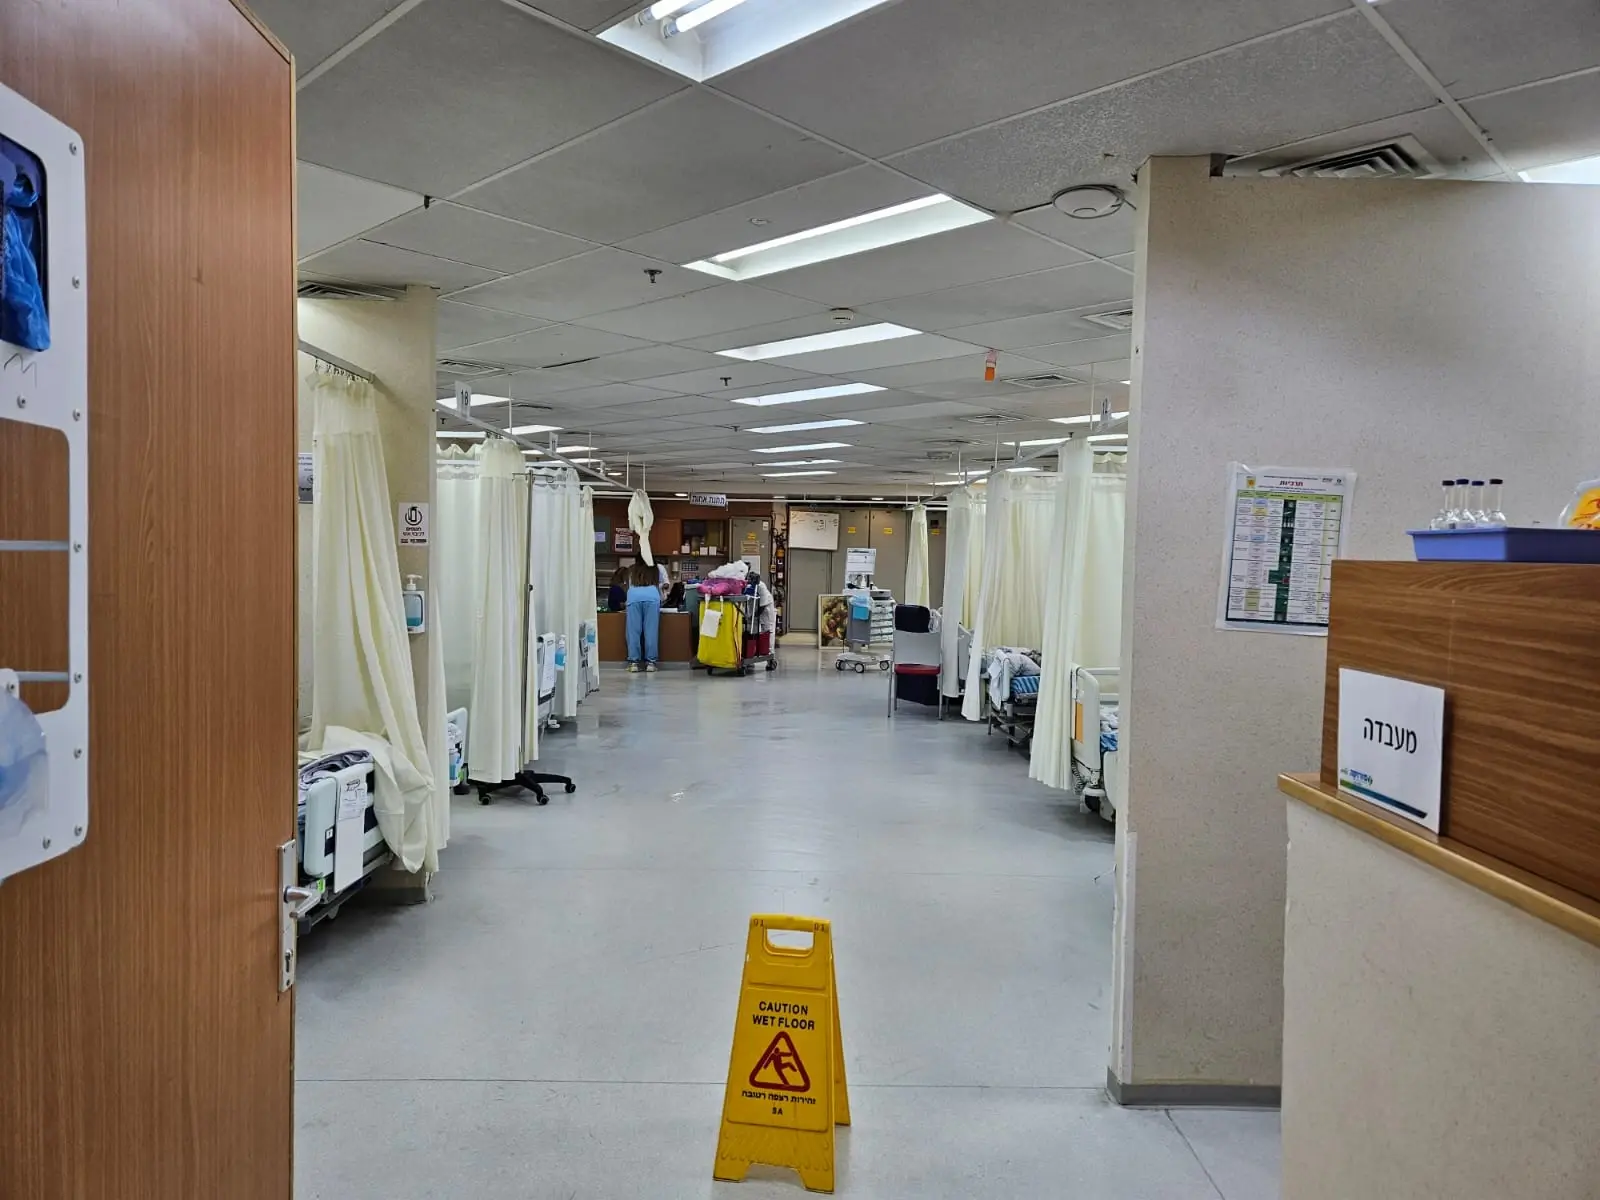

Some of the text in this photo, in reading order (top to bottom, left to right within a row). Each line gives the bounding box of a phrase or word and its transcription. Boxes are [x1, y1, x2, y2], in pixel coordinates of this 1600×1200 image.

[460, 389, 469, 406] 18
[1363, 718, 1417, 754] מעבדה
[758, 1001, 809, 1015] CAUTION
[752, 1014, 815, 1030] WET FLOOR
[741, 1090, 816, 1104] זהירות רצפה רטובה
